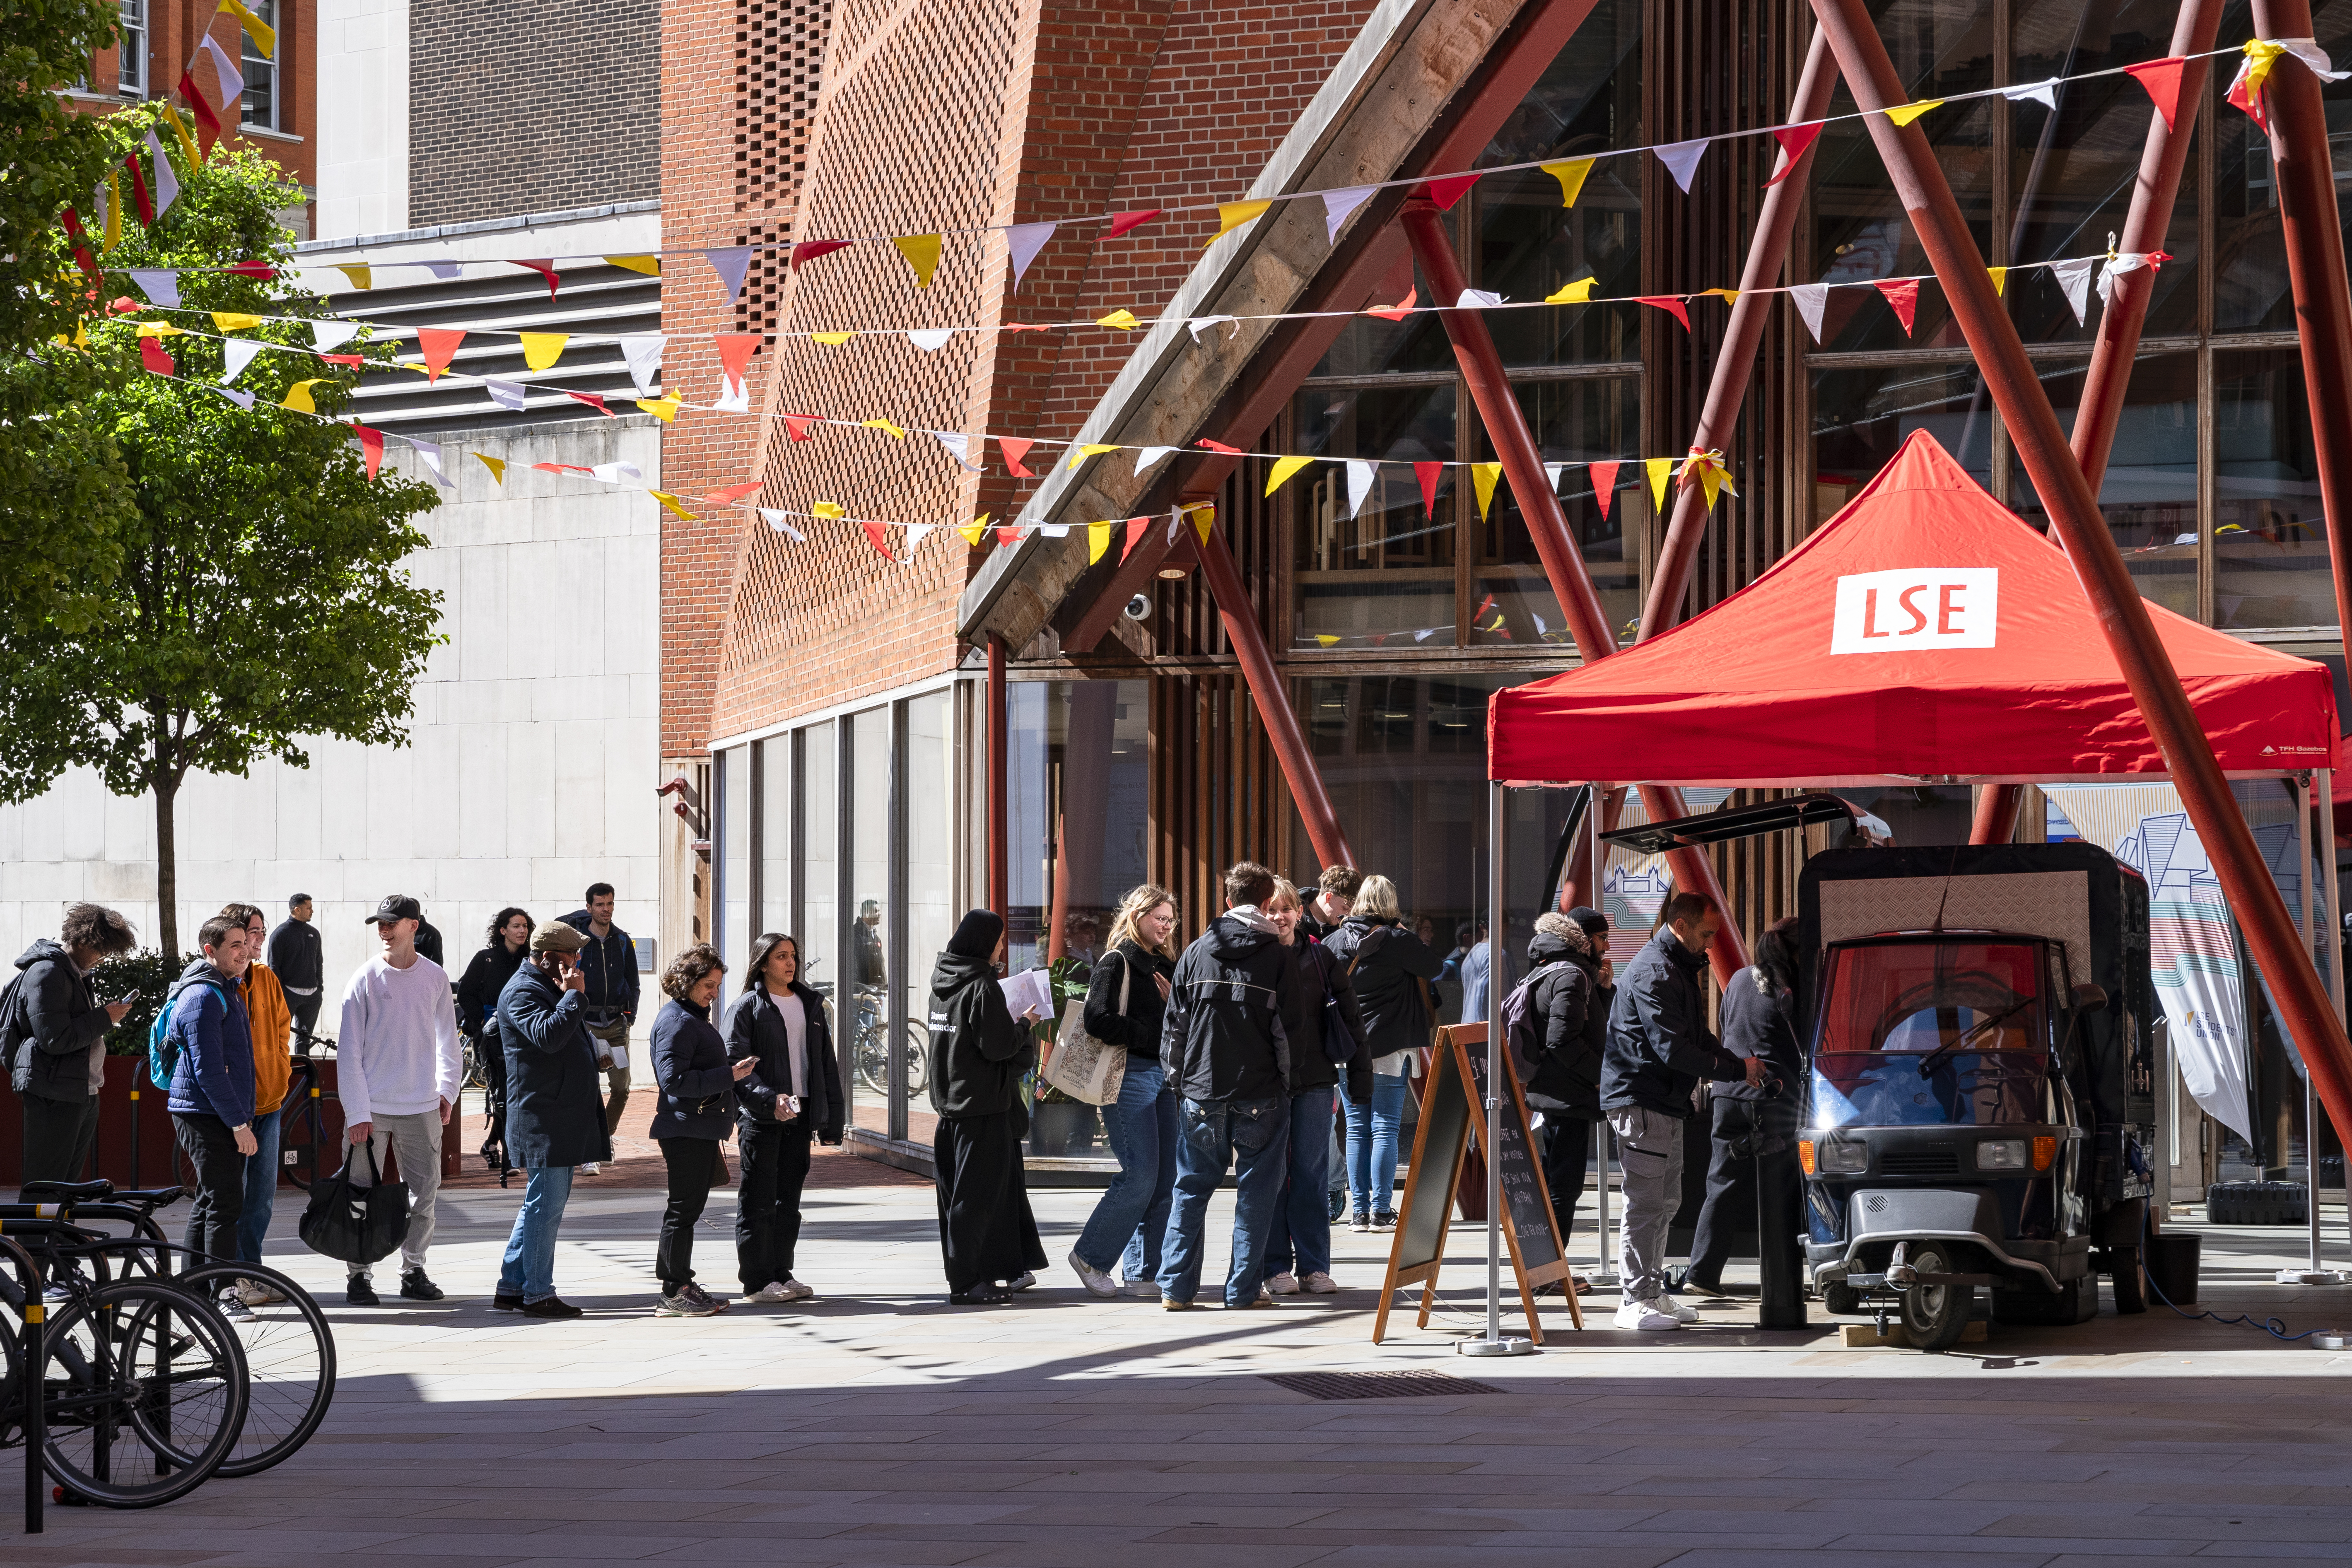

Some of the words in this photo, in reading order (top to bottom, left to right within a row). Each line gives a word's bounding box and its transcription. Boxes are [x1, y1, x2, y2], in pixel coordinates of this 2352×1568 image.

[1863, 585, 1966, 638] LSE
[925, 890, 942, 917] NION
[2197, 1011, 2210, 1021] LSE
[2196, 1020, 2236, 1036] STUDENTS'
[2196, 1029, 2220, 1041] UNION
[1062, 1073, 1079, 1085] WILLIAM
[1513, 1190, 1533, 1205] WRISTBAND
